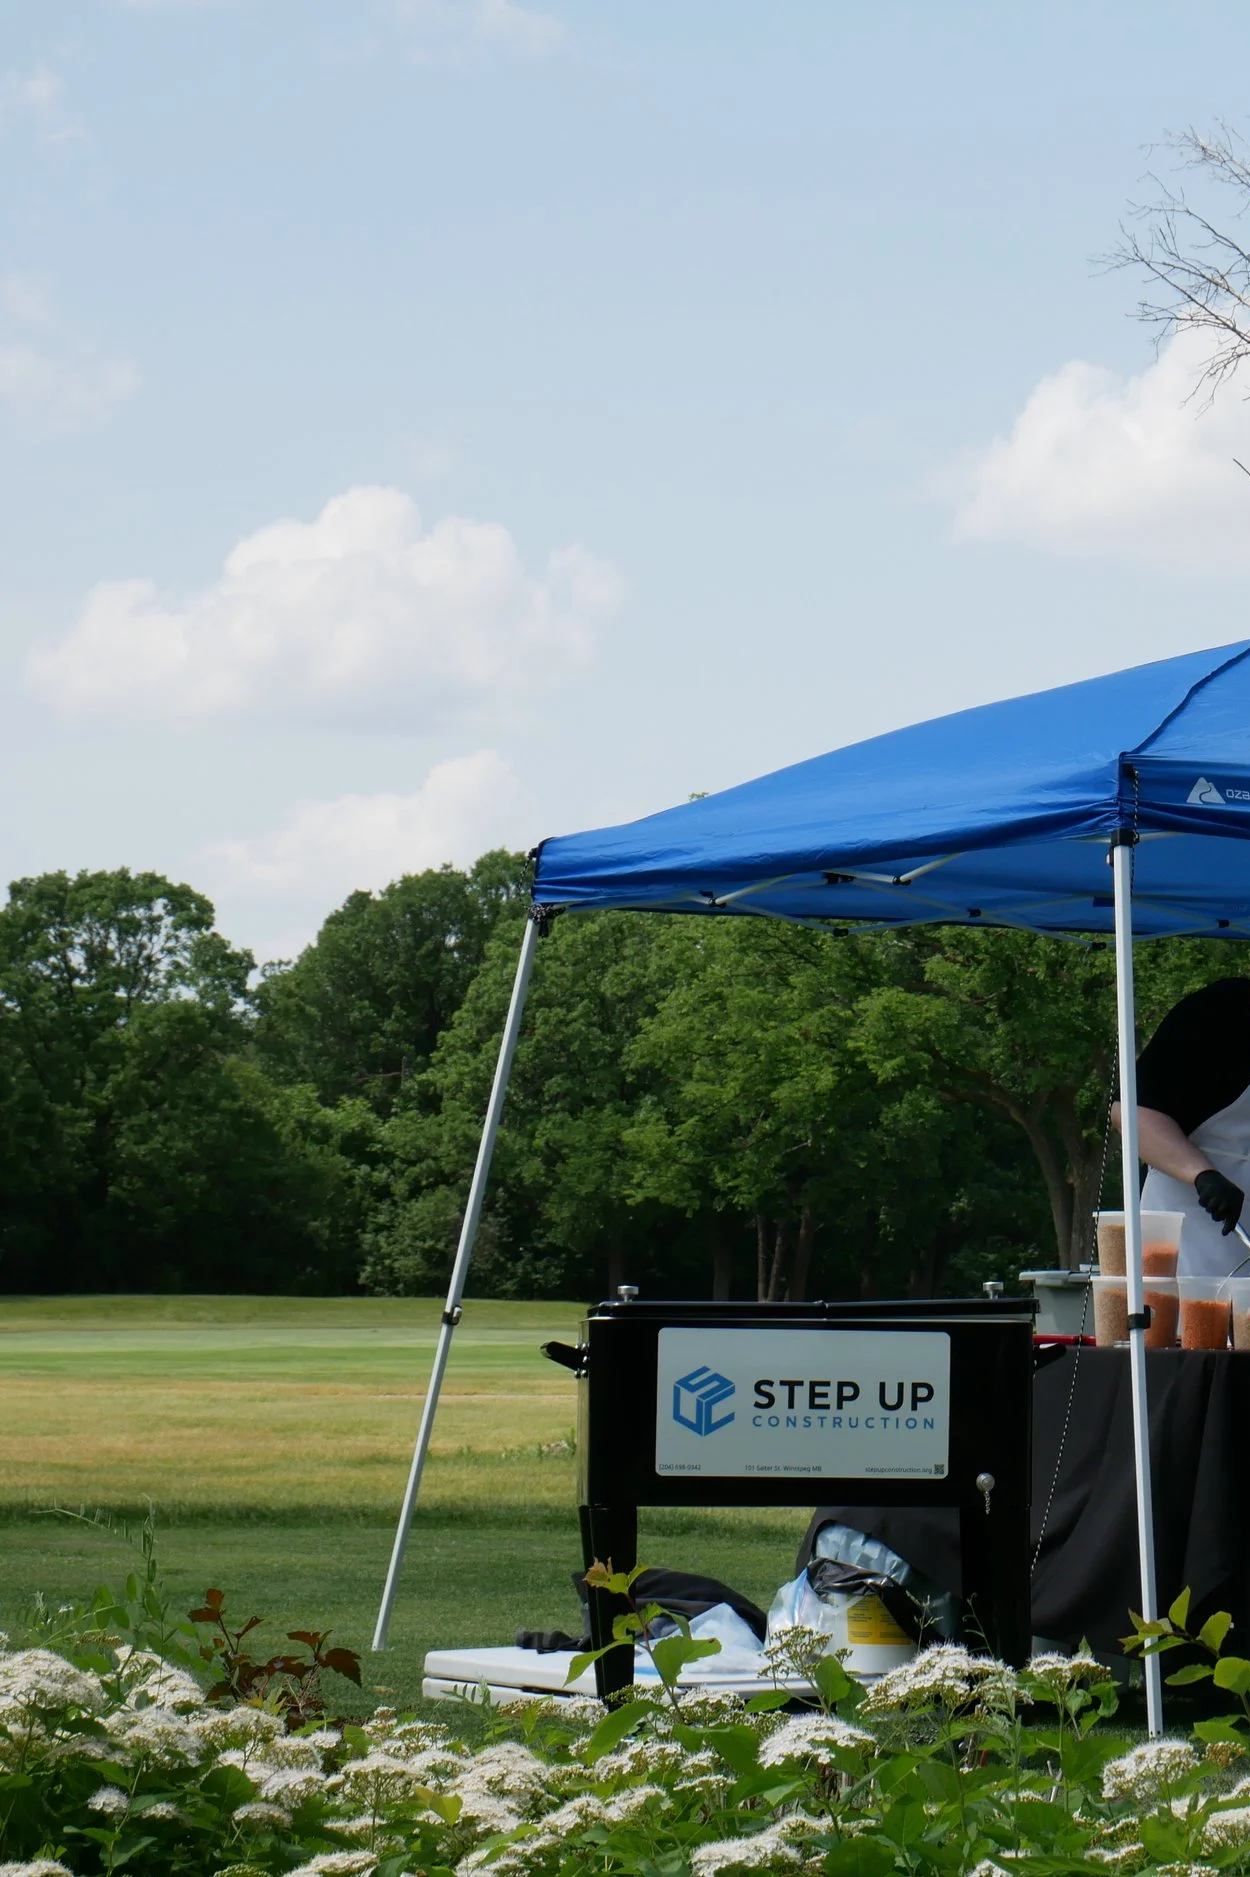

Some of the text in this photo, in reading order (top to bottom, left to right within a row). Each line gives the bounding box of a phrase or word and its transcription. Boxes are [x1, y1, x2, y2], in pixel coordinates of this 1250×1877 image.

[753, 1379, 935, 1411] STEP UP
[752, 1415, 935, 1430] CONSTRUCTION
[783, 1465, 811, 1473] Winnipeg
